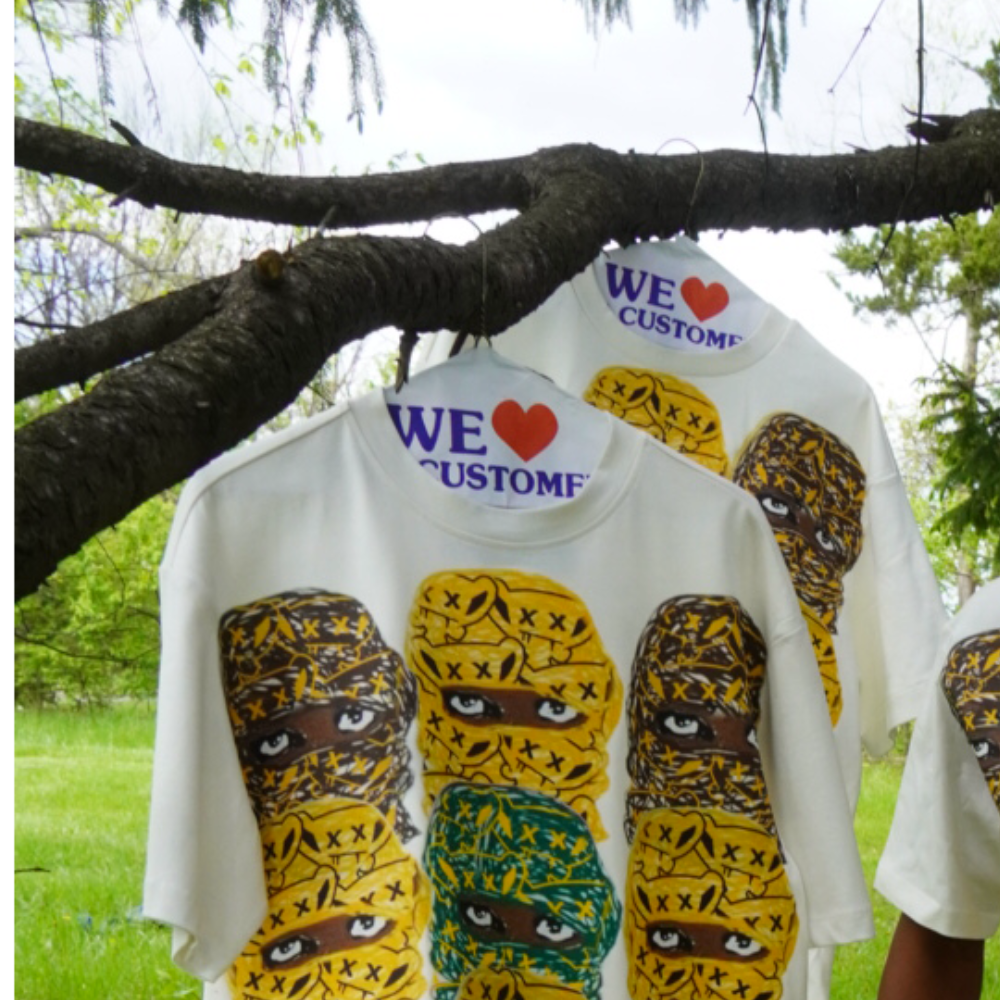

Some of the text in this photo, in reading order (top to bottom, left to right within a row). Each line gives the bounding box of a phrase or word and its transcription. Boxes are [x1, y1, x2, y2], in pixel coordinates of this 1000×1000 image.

[605, 262, 676, 311] WE
[618, 307, 743, 350] CUSTOME
[387, 403, 488, 456] WE
